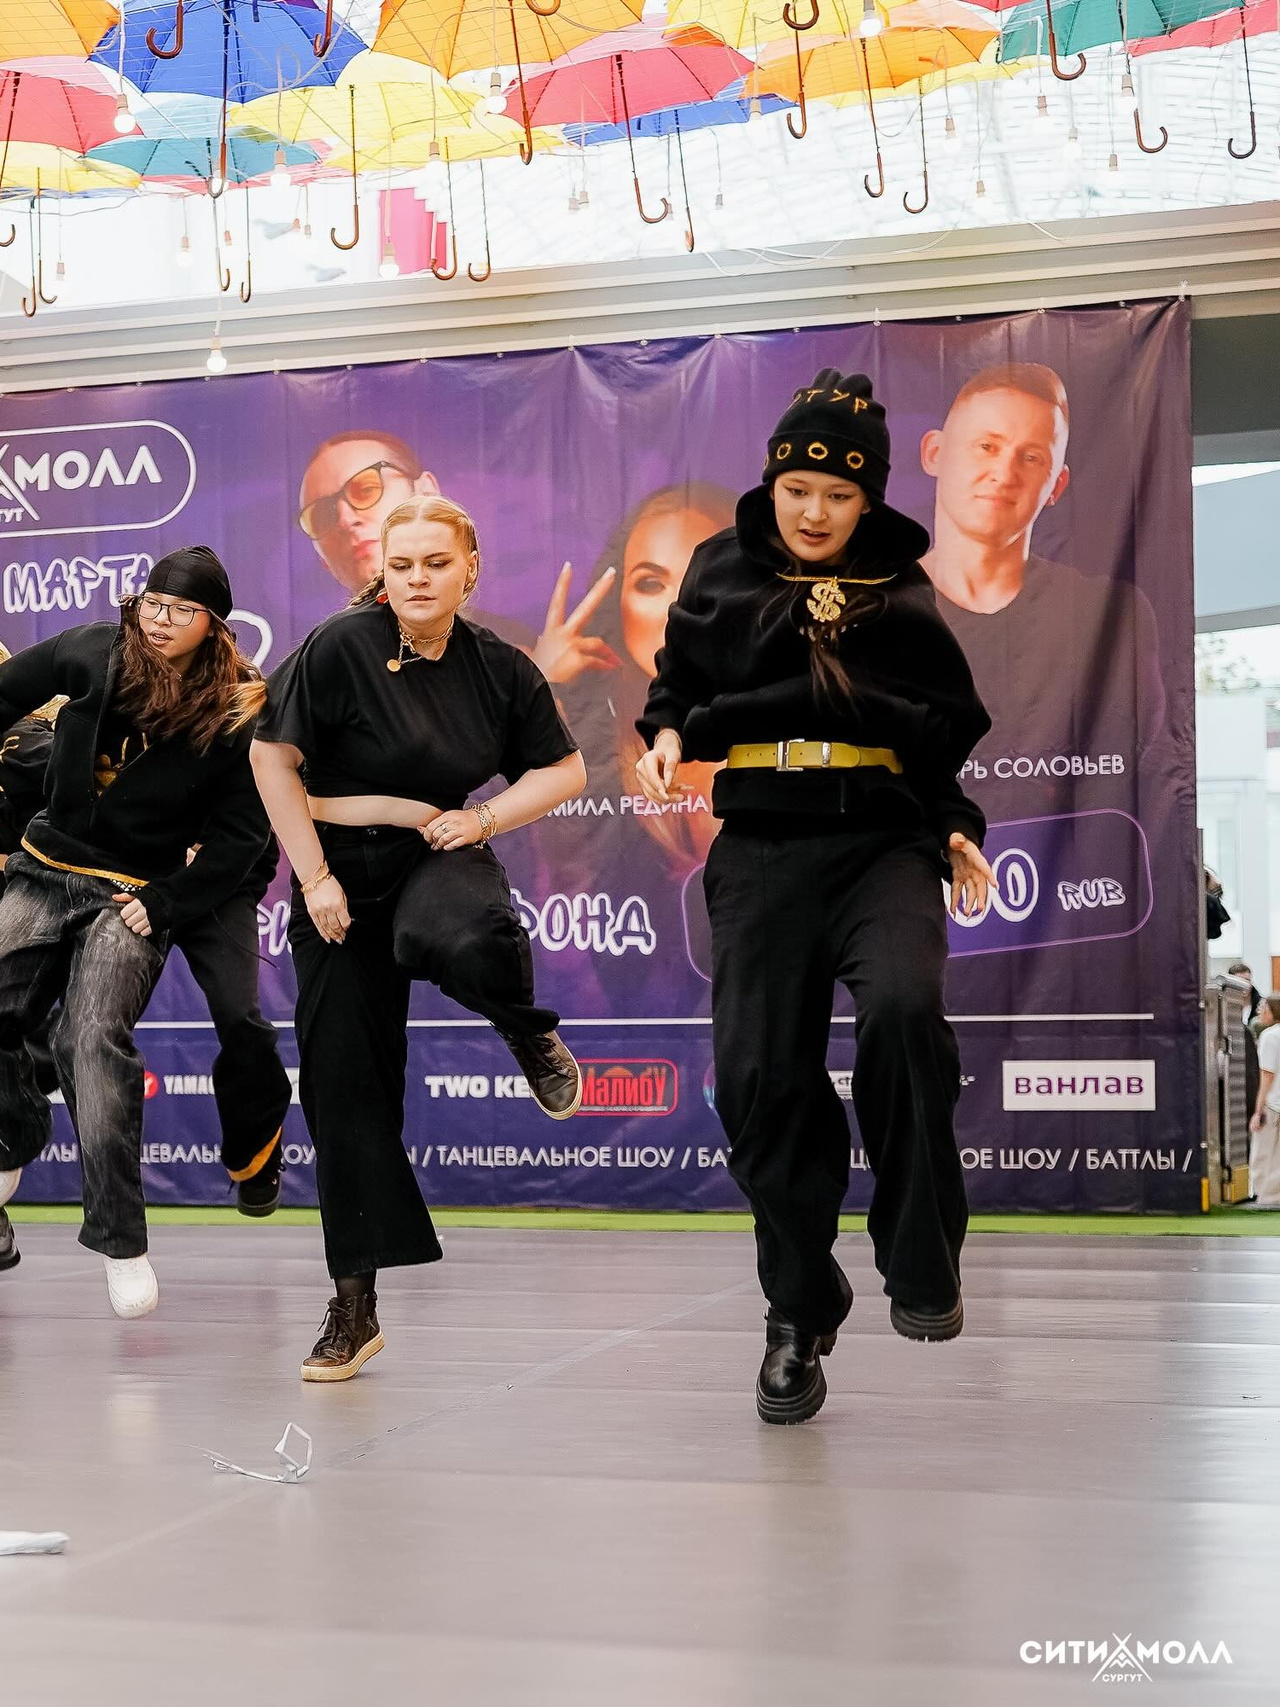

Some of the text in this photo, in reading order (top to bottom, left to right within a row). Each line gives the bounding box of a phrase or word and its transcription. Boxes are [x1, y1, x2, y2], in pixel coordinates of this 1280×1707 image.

[993, 754, 1125, 779] СОЛОВЬЕВ
[546, 797, 615, 818] МИЛА
[1057, 877, 1126, 911] RUB
[424, 1075, 531, 1098] TWO KE
[1014, 1074, 1145, 1096] ванлав
[435, 1145, 611, 1170] ТАНЦЕВАЛЬНОЕ
[617, 1146, 675, 1169] ШОУ
[999, 1148, 1062, 1171] ШОУ
[1086, 1148, 1175, 1170] БАТТЛЫ
